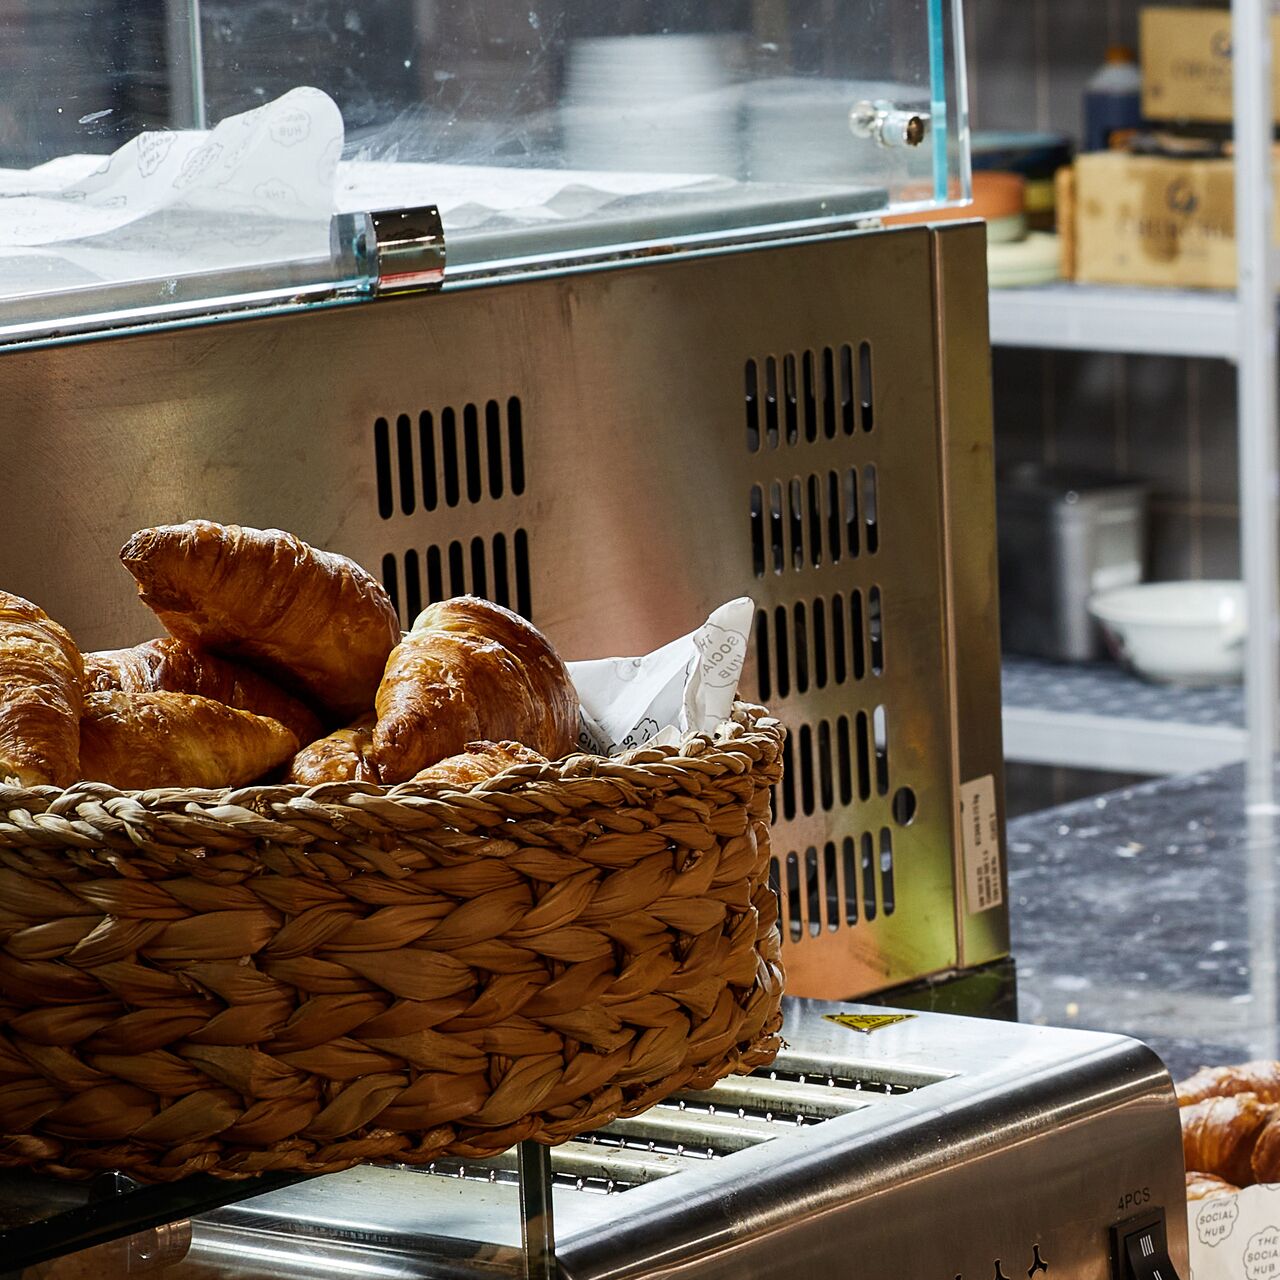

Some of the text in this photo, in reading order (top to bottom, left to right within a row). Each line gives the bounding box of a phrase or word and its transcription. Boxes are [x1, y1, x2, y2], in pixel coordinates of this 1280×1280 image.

[1117, 1187, 1151, 1212] 4PCS
[1199, 1210, 1235, 1225] SOCIAL
[1203, 1225, 1226, 1238] HUB
[1257, 1236, 1280, 1246] THE
[1253, 1263, 1276, 1275] HUB
